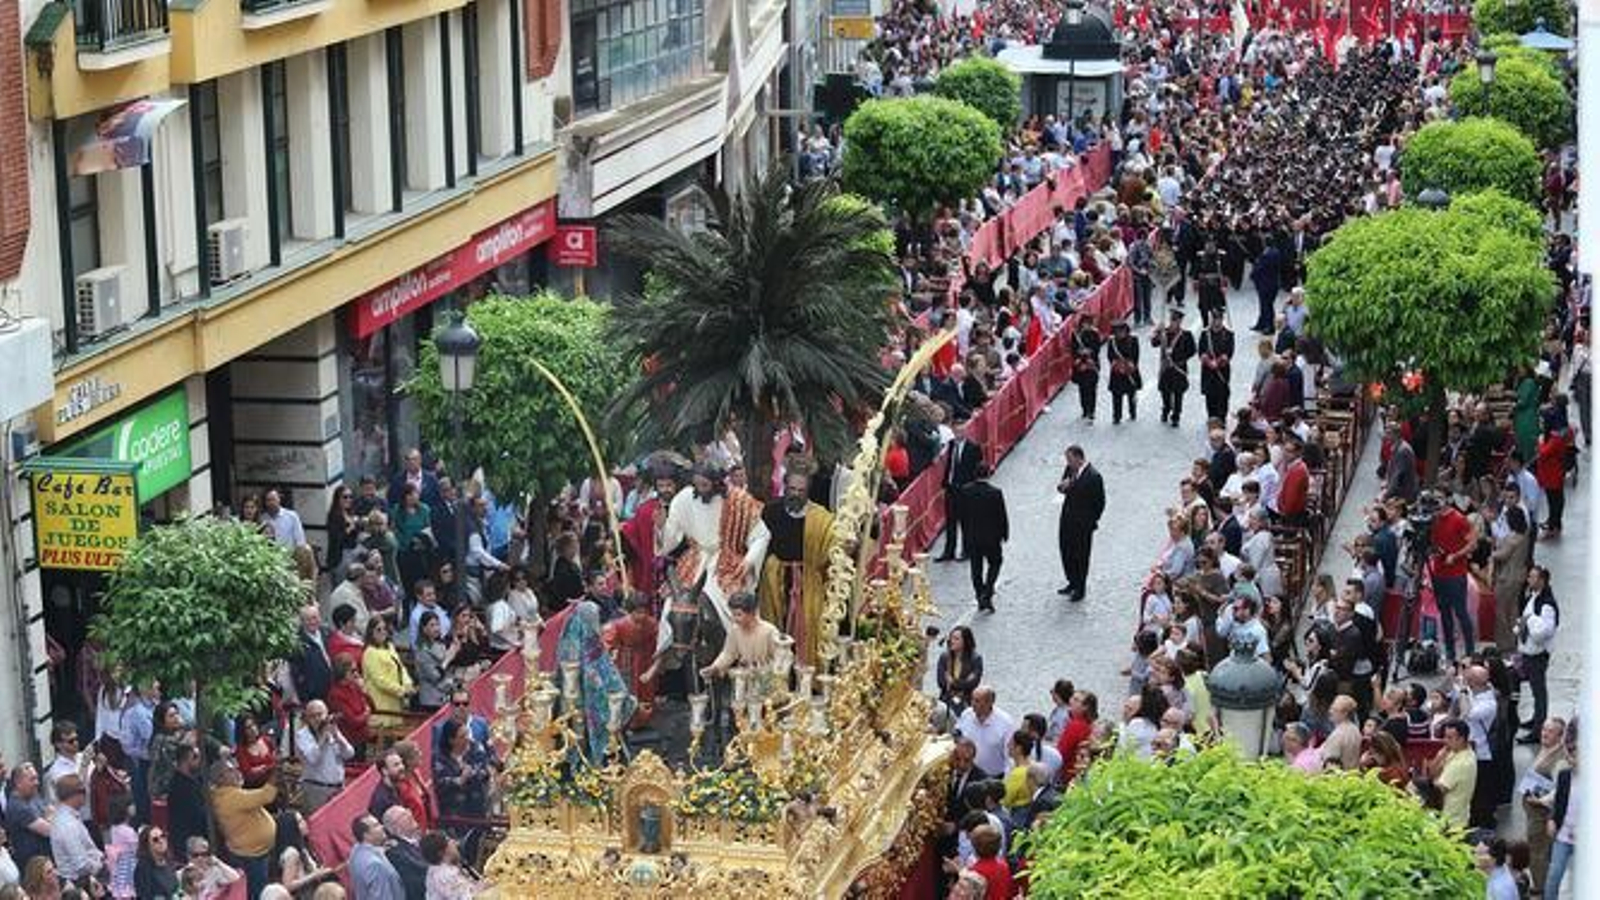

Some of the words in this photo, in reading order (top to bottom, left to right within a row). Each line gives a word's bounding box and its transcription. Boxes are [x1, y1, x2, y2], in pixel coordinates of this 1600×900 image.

[37, 472, 84, 499] Café
[92, 475, 132, 496] Bar
[45, 501, 121, 517] SALON
[72, 520, 100, 531] DE
[42, 549, 81, 564] PLUS
